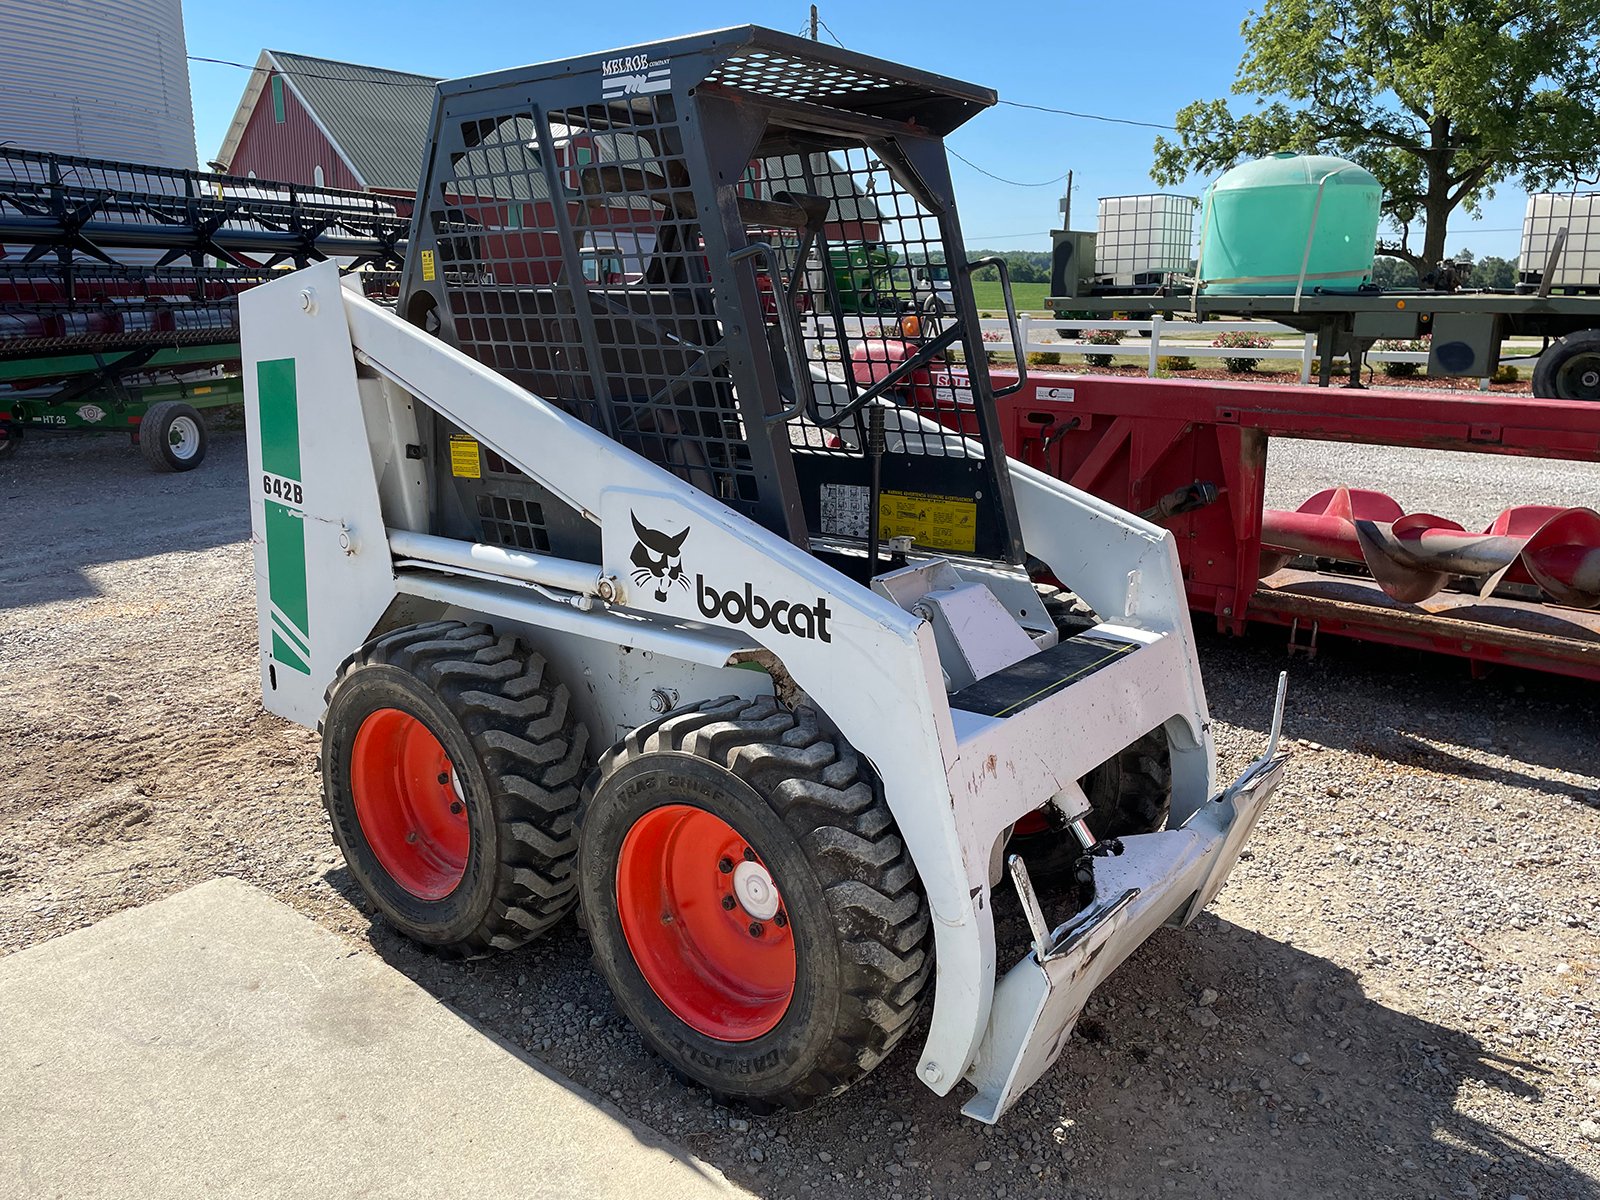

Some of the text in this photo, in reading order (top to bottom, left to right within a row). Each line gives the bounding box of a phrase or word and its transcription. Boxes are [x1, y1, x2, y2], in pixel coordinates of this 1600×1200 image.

[602, 54, 671, 76] MELROE COMPANY
[43, 415, 54, 424] HT
[56, 415, 67, 424] 25
[263, 475, 303, 505] 642B
[696, 573, 832, 644] bobcat
